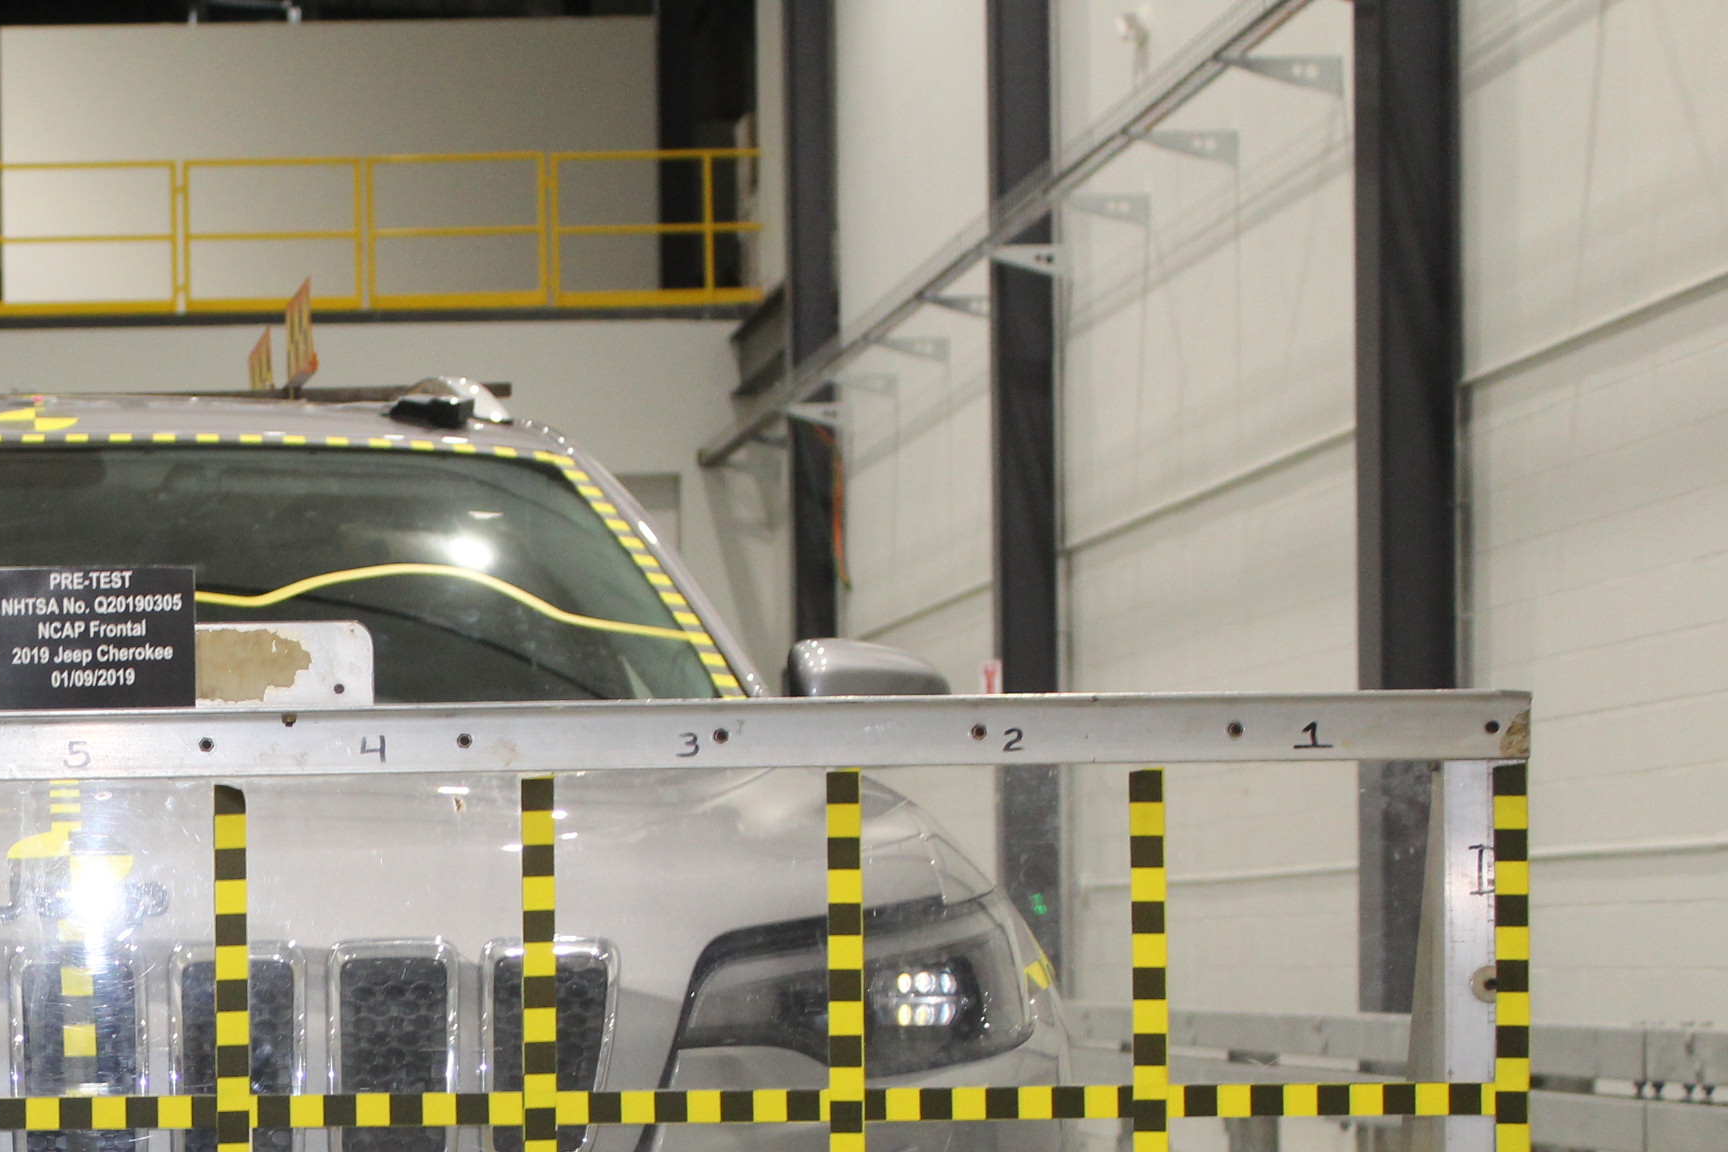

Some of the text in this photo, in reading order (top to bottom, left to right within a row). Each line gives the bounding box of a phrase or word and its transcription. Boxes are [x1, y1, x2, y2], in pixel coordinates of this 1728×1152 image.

[49, 570, 133, 591] PRE-TEST
[1, 593, 183, 616] NHTSA No. Q20190305
[37, 618, 147, 640] NCAP Frontal
[11, 643, 174, 667] 2019 Jeep Cherokee
[50, 667, 136, 688] 01/09/2019
[63, 741, 91, 769] 5
[359, 734, 388, 763] 4
[676, 732, 700, 758] 3
[1002, 727, 1024, 752] 2
[1292, 720, 1333, 750] 1
